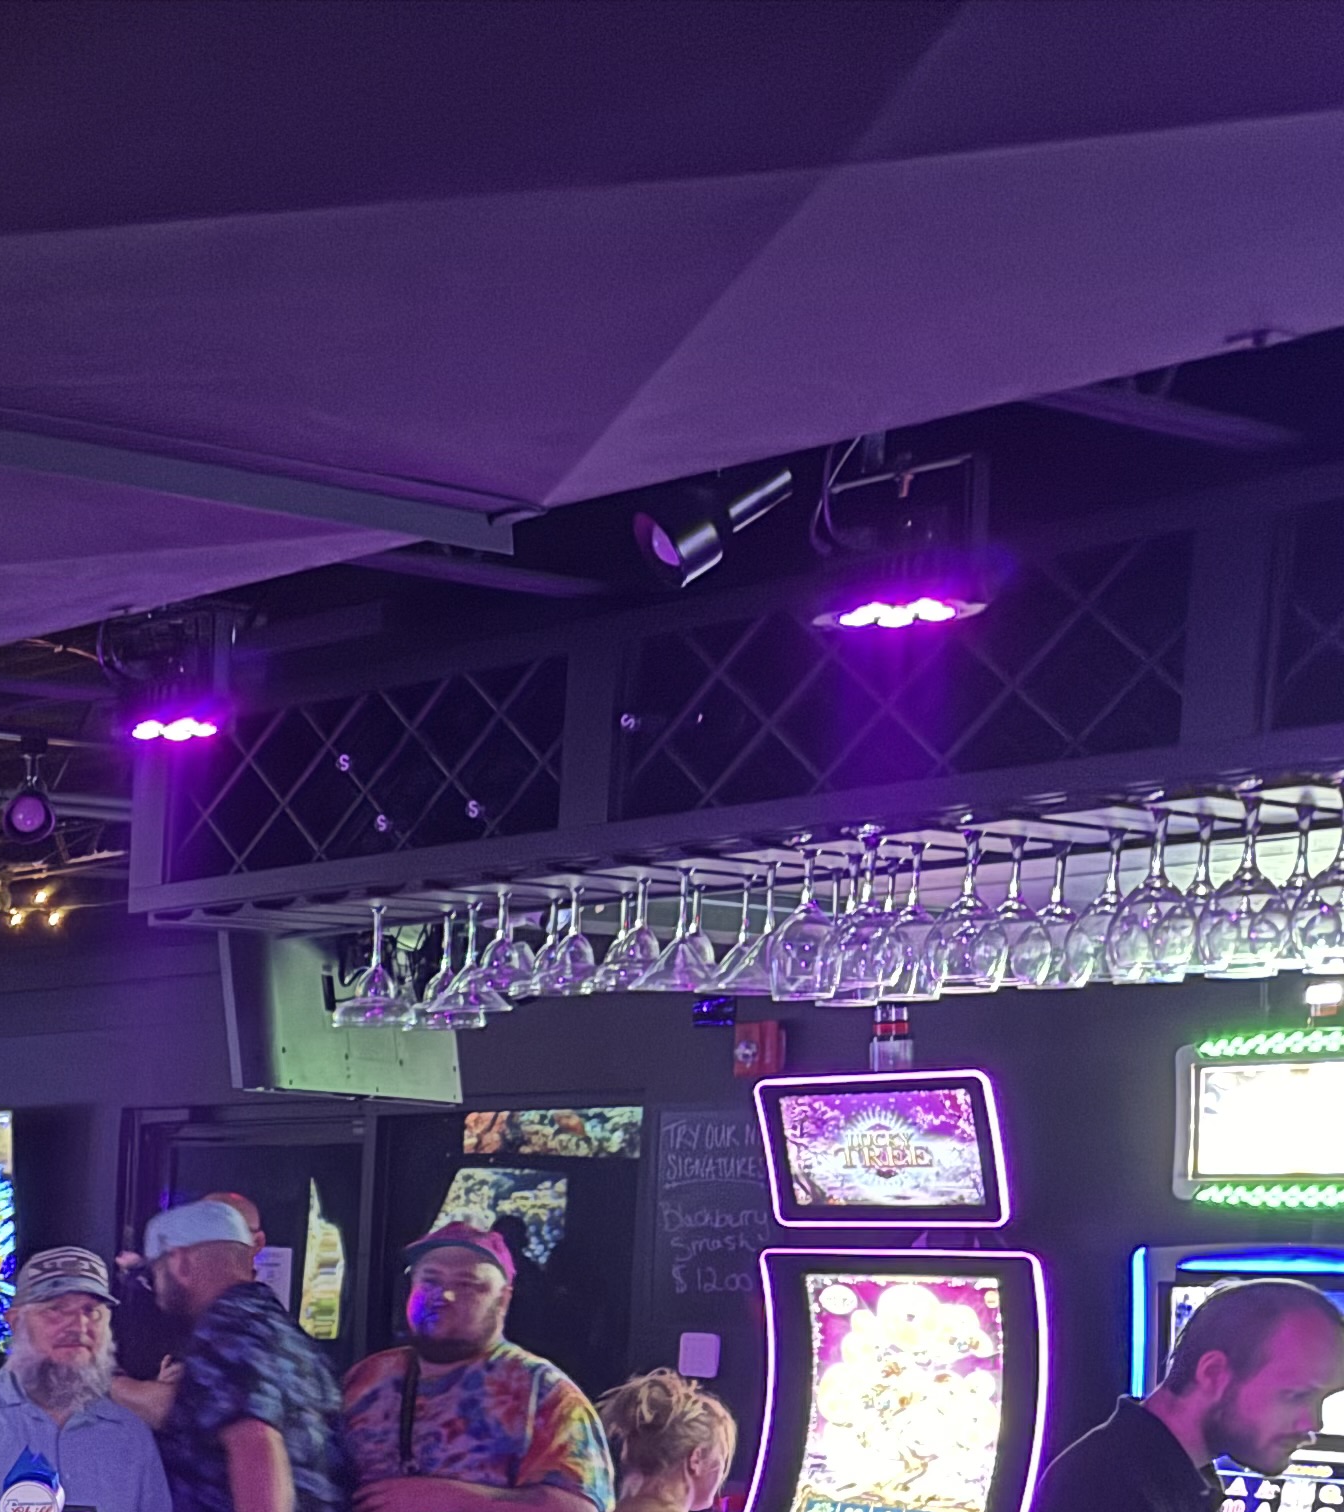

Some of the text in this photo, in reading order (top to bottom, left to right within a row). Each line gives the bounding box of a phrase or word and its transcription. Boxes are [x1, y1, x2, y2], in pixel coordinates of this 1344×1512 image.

[663, 1120, 701, 1150] TRY
[705, 1123, 740, 1149] OUR
[845, 1130, 914, 1149] LUCKY
[834, 1145, 934, 1170] TREE
[662, 1202, 770, 1242] Blackberry
[670, 1232, 756, 1262] Smash
